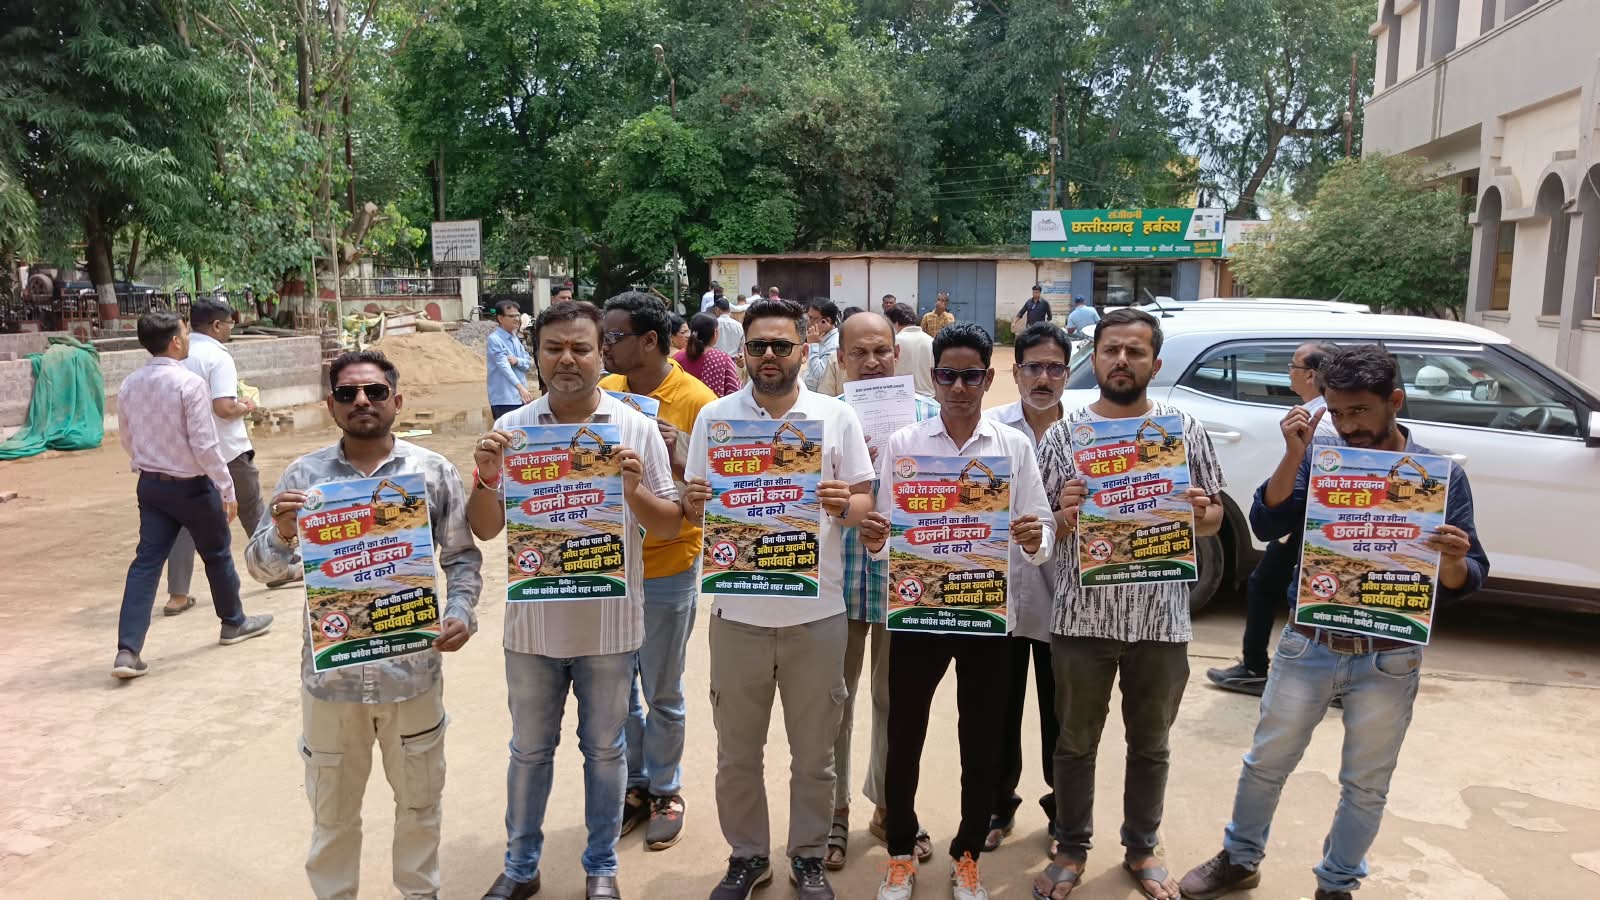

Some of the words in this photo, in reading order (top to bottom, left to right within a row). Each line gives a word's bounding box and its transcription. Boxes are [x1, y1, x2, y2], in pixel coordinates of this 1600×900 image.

[1071, 217, 1134, 237] छत्तीसगढ़
[1143, 216, 1181, 234] हर्बल्स
[510, 456, 528, 466] अवैध
[529, 454, 539, 464] रेत
[541, 454, 569, 463] उत्खनन
[713, 448, 731, 458] अवैध
[732, 447, 742, 457] रेत
[744, 448, 771, 456] उत्खनन
[1078, 451, 1096, 462] अवैध
[1097, 449, 1107, 458] रेत
[1108, 446, 1136, 457] उत्खनन
[521, 465, 542, 480] बंद
[544, 463, 559, 479] हो
[723, 457, 744, 473] बंद
[746, 457, 761, 473] हो
[1089, 459, 1110, 475] बंद
[1112, 456, 1127, 472] हो
[533, 484, 561, 495] महानदी
[575, 482, 591, 490] सीना
[733, 478, 761, 488] महानदी
[775, 477, 791, 485] सीना
[1101, 476, 1130, 488] महानदी
[1143, 473, 1160, 481] सीना
[1318, 477, 1338, 488] अवैध
[1340, 478, 1351, 488] रेत
[1353, 481, 1385, 490] उत्खनन
[729, 489, 765, 505] छलनी
[767, 489, 798, 500] करना
[897, 484, 915, 495] अवैध
[917, 484, 927, 493] रेत
[1099, 486, 1134, 505] छलनी
[1136, 482, 1168, 496] करना
[1329, 488, 1352, 505] बंद
[1355, 489, 1372, 506] हो
[530, 494, 565, 512] छलनी
[568, 493, 599, 505] करना
[747, 506, 763, 516] बंद
[766, 503, 785, 515] करो
[907, 494, 929, 510] बंद
[931, 494, 947, 510] हो
[1118, 503, 1134, 513] बंद
[1137, 497, 1156, 510] करो
[305, 516, 326, 528] अवैध
[327, 513, 339, 523] रेत
[339, 509, 371, 521] उत्खनन
[549, 512, 565, 522] बंद
[568, 507, 587, 519] करो
[918, 515, 947, 525] महानदी
[961, 515, 978, 523] सीना
[1338, 512, 1371, 521] महानदी
[1387, 514, 1406, 522] सीना
[318, 524, 342, 541] बंद
[344, 520, 361, 538] हो
[914, 526, 951, 542] छलनी
[953, 527, 986, 538] करना
[1333, 523, 1374, 538] छलनी
[1376, 527, 1414, 538] करना
[333, 541, 365, 556] महानदी
[380, 537, 398, 546] सीना
[933, 543, 949, 554] बंद
[952, 541, 972, 552] करो
[1134, 542, 1171, 557] कार्यवाही
[1172, 538, 1190, 552] करो
[1353, 540, 1371, 552] बंद
[1374, 540, 1397, 552] करो
[331, 552, 370, 574] छलनी
[372, 546, 407, 562] करना
[564, 555, 602, 570] कार्यवाही
[603, 552, 621, 566] करो
[758, 553, 796, 566] कार्यवाही
[797, 551, 816, 565] करो
[353, 571, 372, 582] बंद
[374, 563, 396, 577] करो
[402, 592, 414, 600] पास
[944, 590, 983, 603] कार्यवाही
[985, 589, 1004, 602] करो
[1361, 592, 1406, 607] कार्यवाही
[1407, 594, 1429, 608] करो
[373, 611, 415, 631] कार्यवाही
[416, 606, 436, 621] करो
